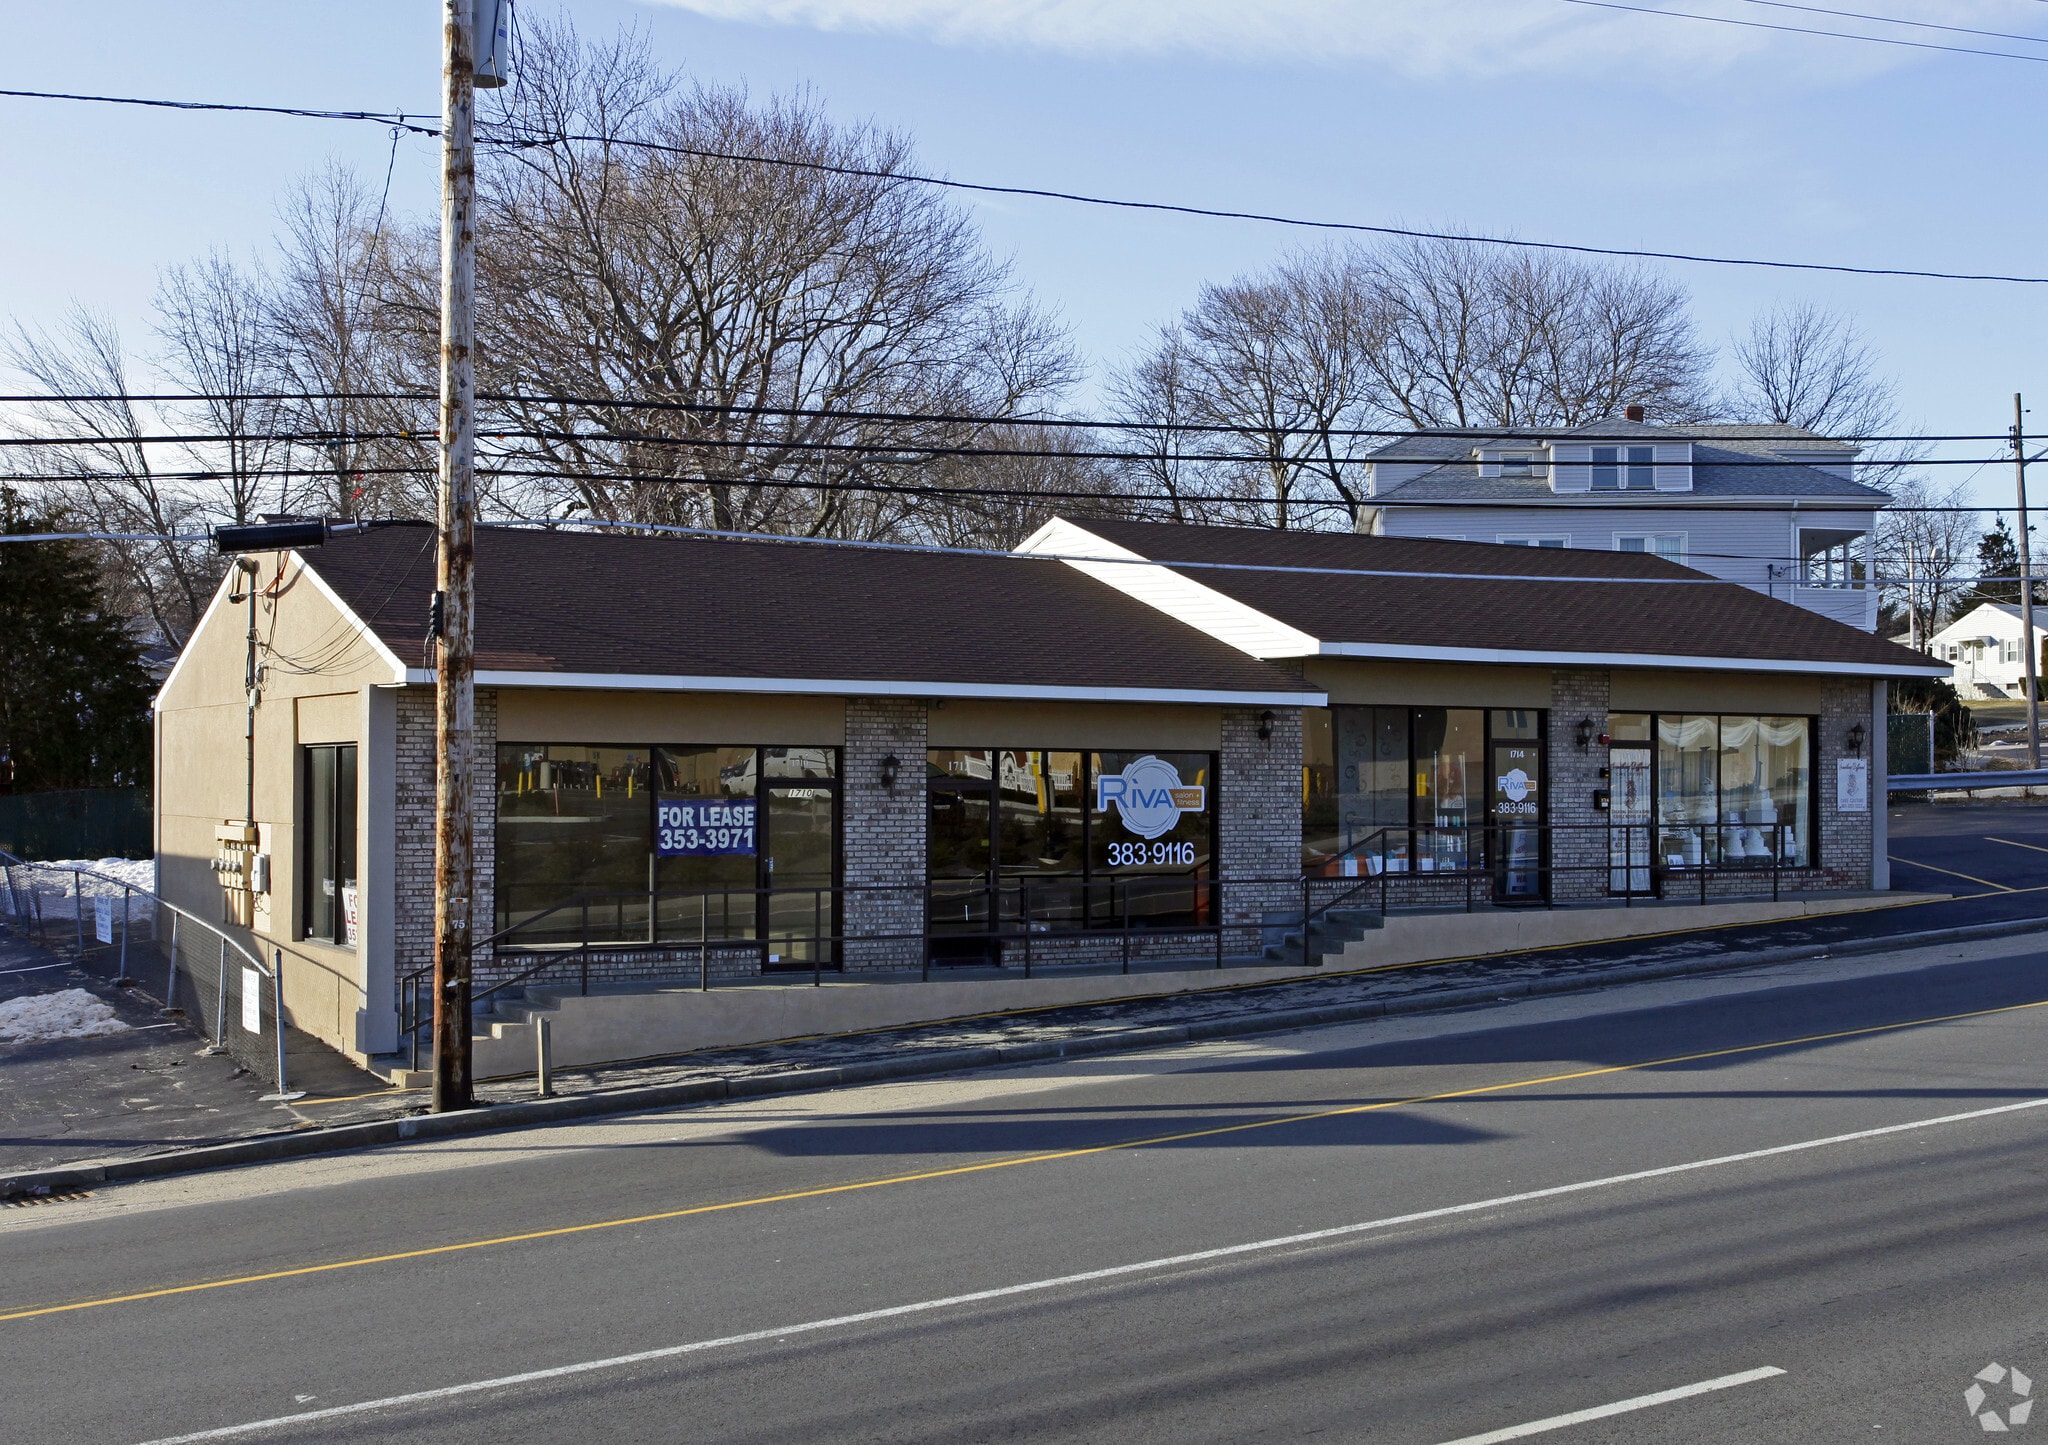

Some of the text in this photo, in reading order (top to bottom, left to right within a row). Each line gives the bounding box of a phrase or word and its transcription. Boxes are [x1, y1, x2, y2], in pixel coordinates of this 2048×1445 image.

[790, 789, 812, 797] 1710
[658, 806, 755, 828] FOR LEASE
[660, 828, 754, 850] 353-3971
[345, 909, 357, 925] LE
[452, 919, 466, 929] 75
